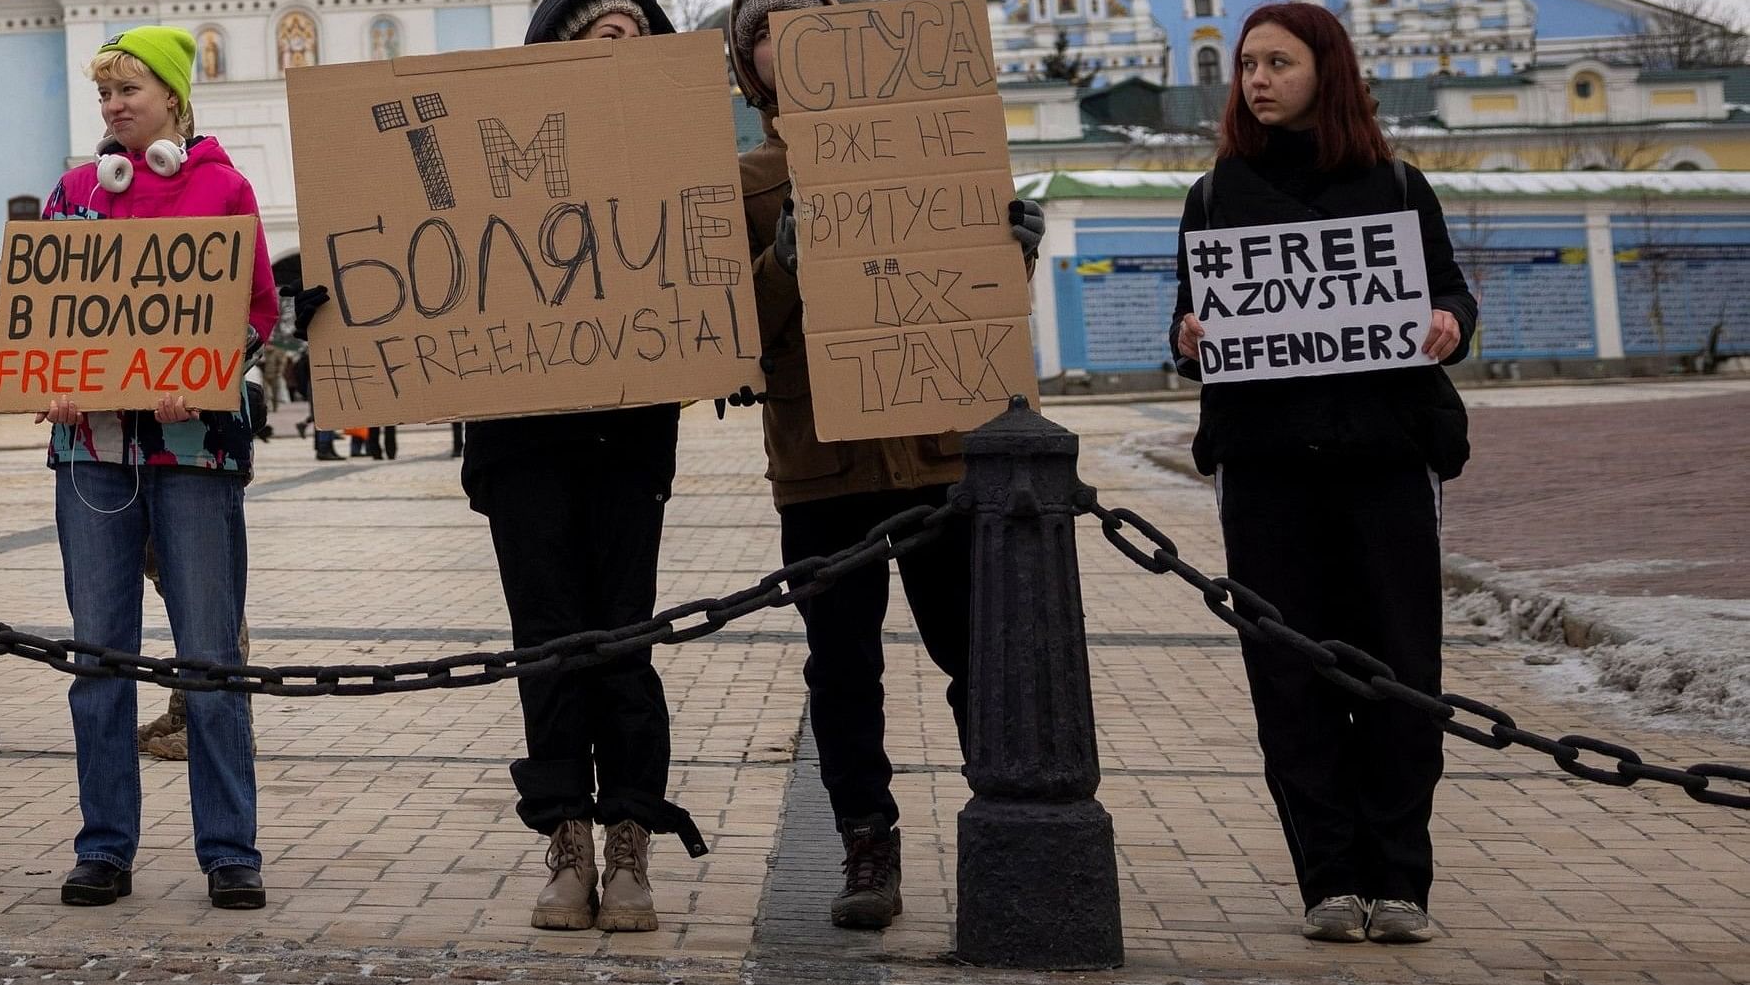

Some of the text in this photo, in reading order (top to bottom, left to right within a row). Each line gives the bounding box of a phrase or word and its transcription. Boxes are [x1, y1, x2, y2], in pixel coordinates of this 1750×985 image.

[778, 1, 994, 111] СТУСА
[371, 92, 571, 211] ЇМ
[814, 110, 986, 165] ВЖЕ НЕ
[810, 184, 1000, 249] ВРЯТУЄШ
[7, 230, 241, 289] ВОНИ ДОСІ
[327, 184, 741, 327] БОЛЯЧЕ
[1190, 223, 1398, 279] #FREE
[8, 293, 213, 340] В ПОЛОНІ
[1199, 269, 1422, 321] AZOVSTAL
[120, 347, 241, 391] AZOV
[314, 285, 756, 410] #FREEAZOVSTAL
[825, 324, 1013, 412] ТАК
[1200, 321, 1419, 374] DEFENDERS
